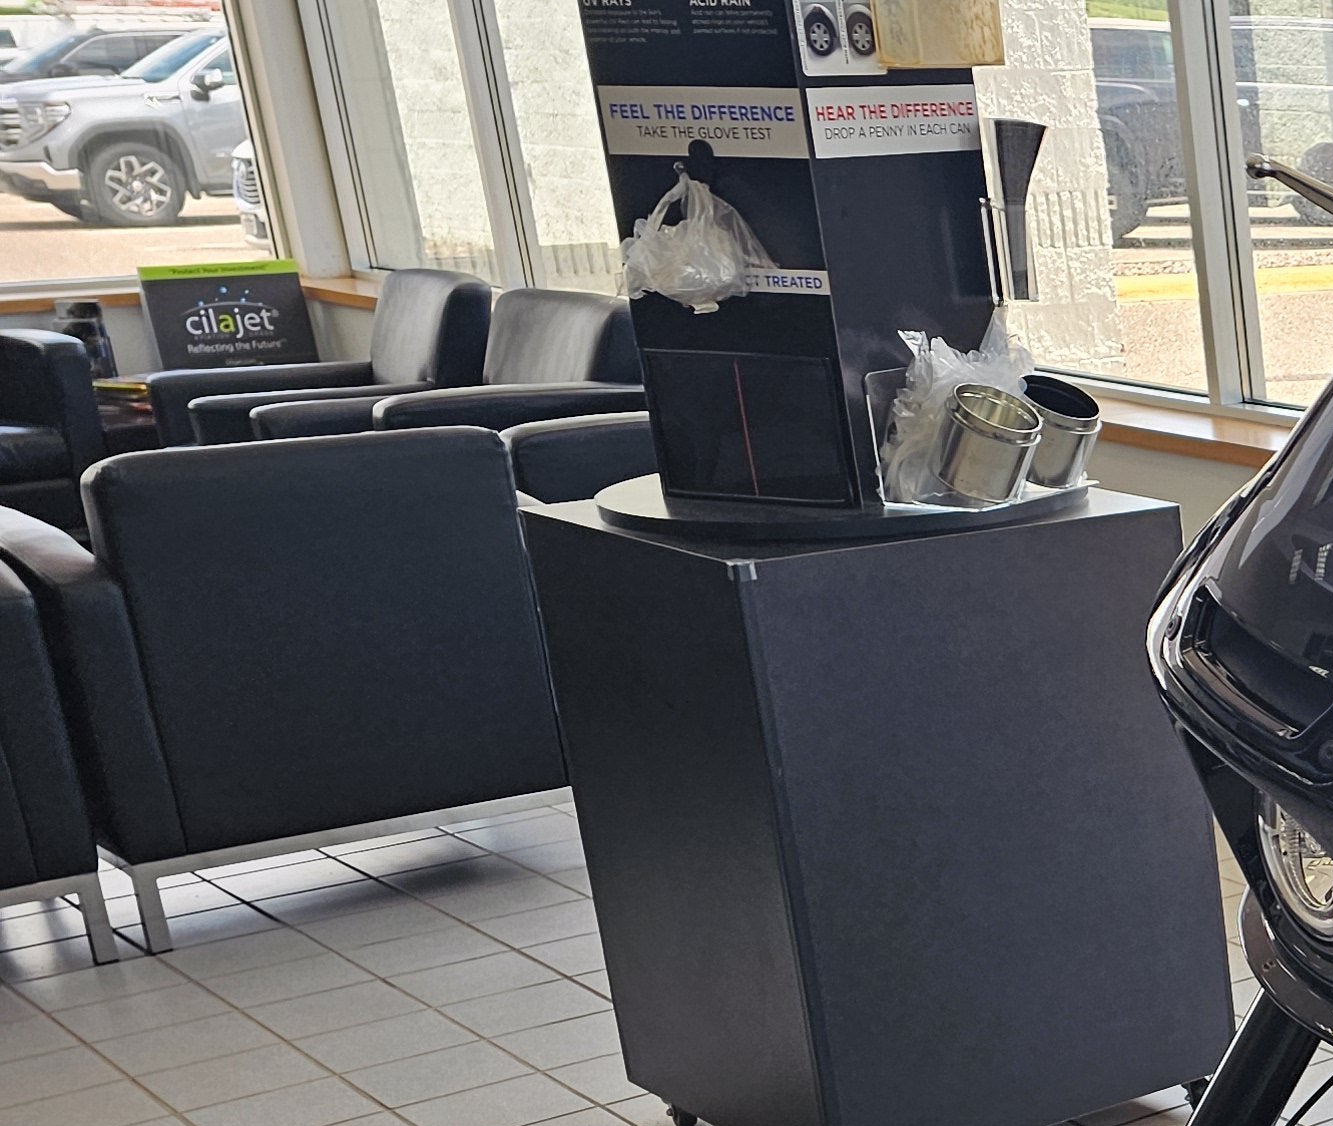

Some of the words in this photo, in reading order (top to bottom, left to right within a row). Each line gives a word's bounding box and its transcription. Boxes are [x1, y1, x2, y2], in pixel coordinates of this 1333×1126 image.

[609, 103, 650, 119] FEEL
[653, 104, 685, 120] THE
[691, 105, 795, 122] DIFFERENCE
[815, 105, 856, 121] HEAR
[859, 104, 887, 120] THE
[890, 102, 974, 119] DIFFERENCE
[636, 125, 668, 138] TAKE
[671, 126, 695, 138] THE
[698, 126, 741, 140] GLOVE
[743, 127, 772, 140] TEST
[825, 127, 855, 140] DROP
[859, 126, 867, 138] A
[869, 125, 904, 138] PENNY
[907, 124, 918, 136] IN
[920, 123, 947, 136] EACH
[950, 122, 971, 135] CAN
[764, 275, 823, 289] TREATED
[186, 307, 275, 339] cilajet
